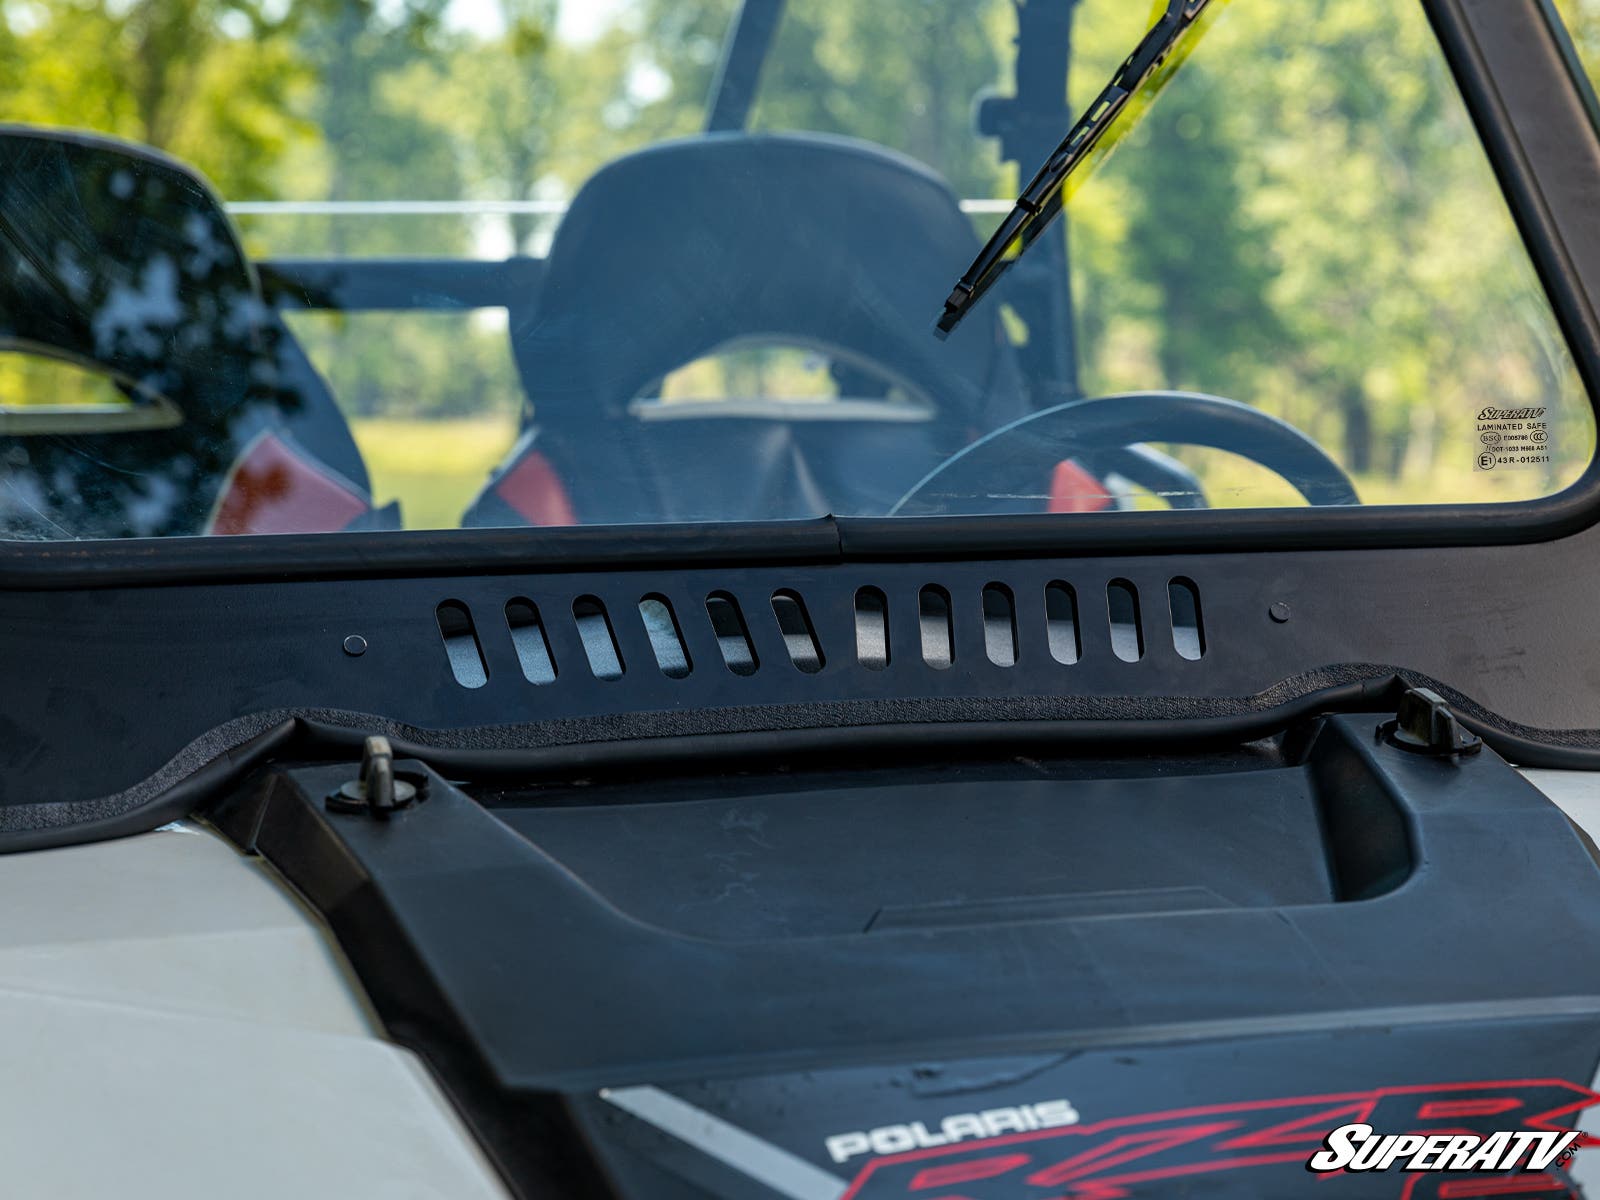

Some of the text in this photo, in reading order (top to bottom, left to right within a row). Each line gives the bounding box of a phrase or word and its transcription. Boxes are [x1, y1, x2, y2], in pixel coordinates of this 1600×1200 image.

[1477, 423, 1523, 431] LAMINATED
[1480, 456, 1492, 466] E1
[826, 1100, 1079, 1163] POLARIS
